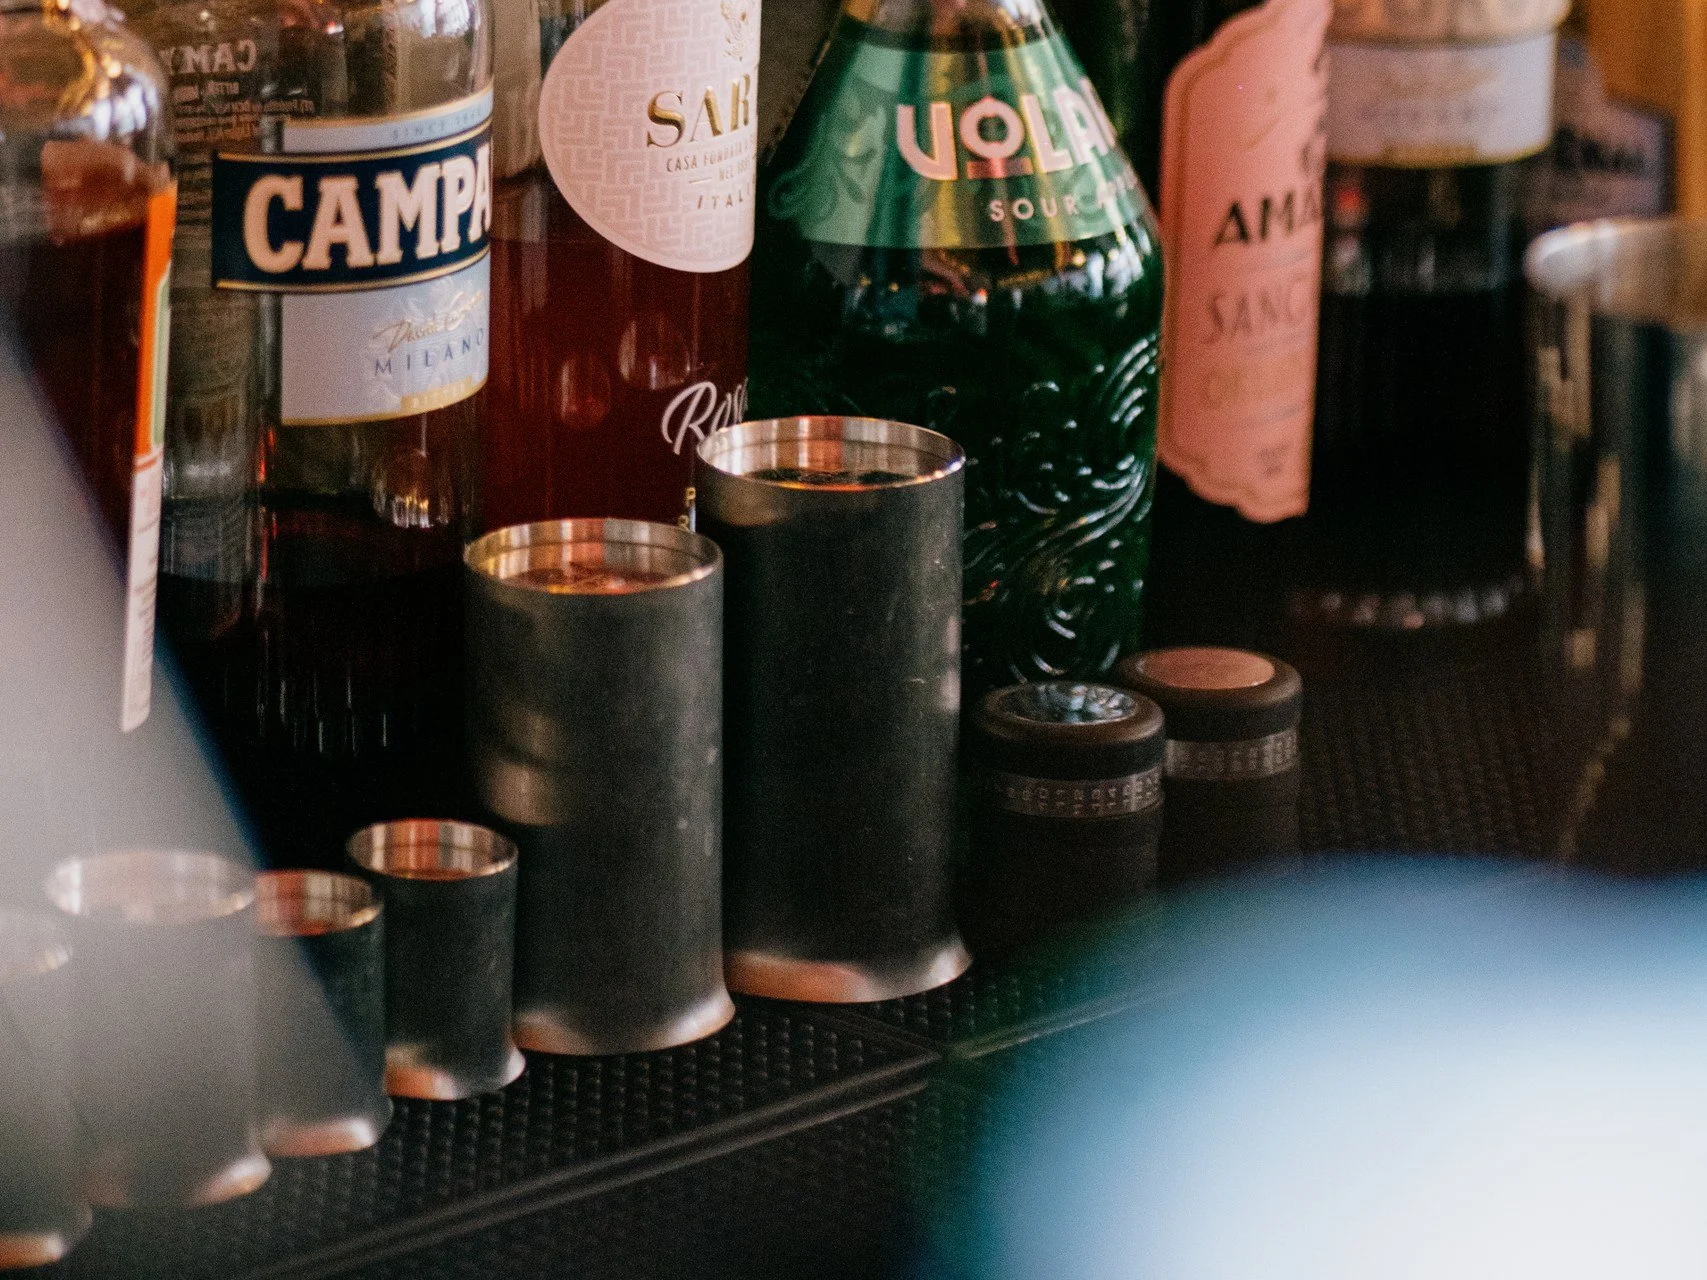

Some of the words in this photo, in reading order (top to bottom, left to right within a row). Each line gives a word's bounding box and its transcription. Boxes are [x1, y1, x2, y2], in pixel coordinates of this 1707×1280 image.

[665, 154, 698, 173] CASA
[989, 193, 1080, 222] SOUR
[374, 326, 485, 377] MILANO
